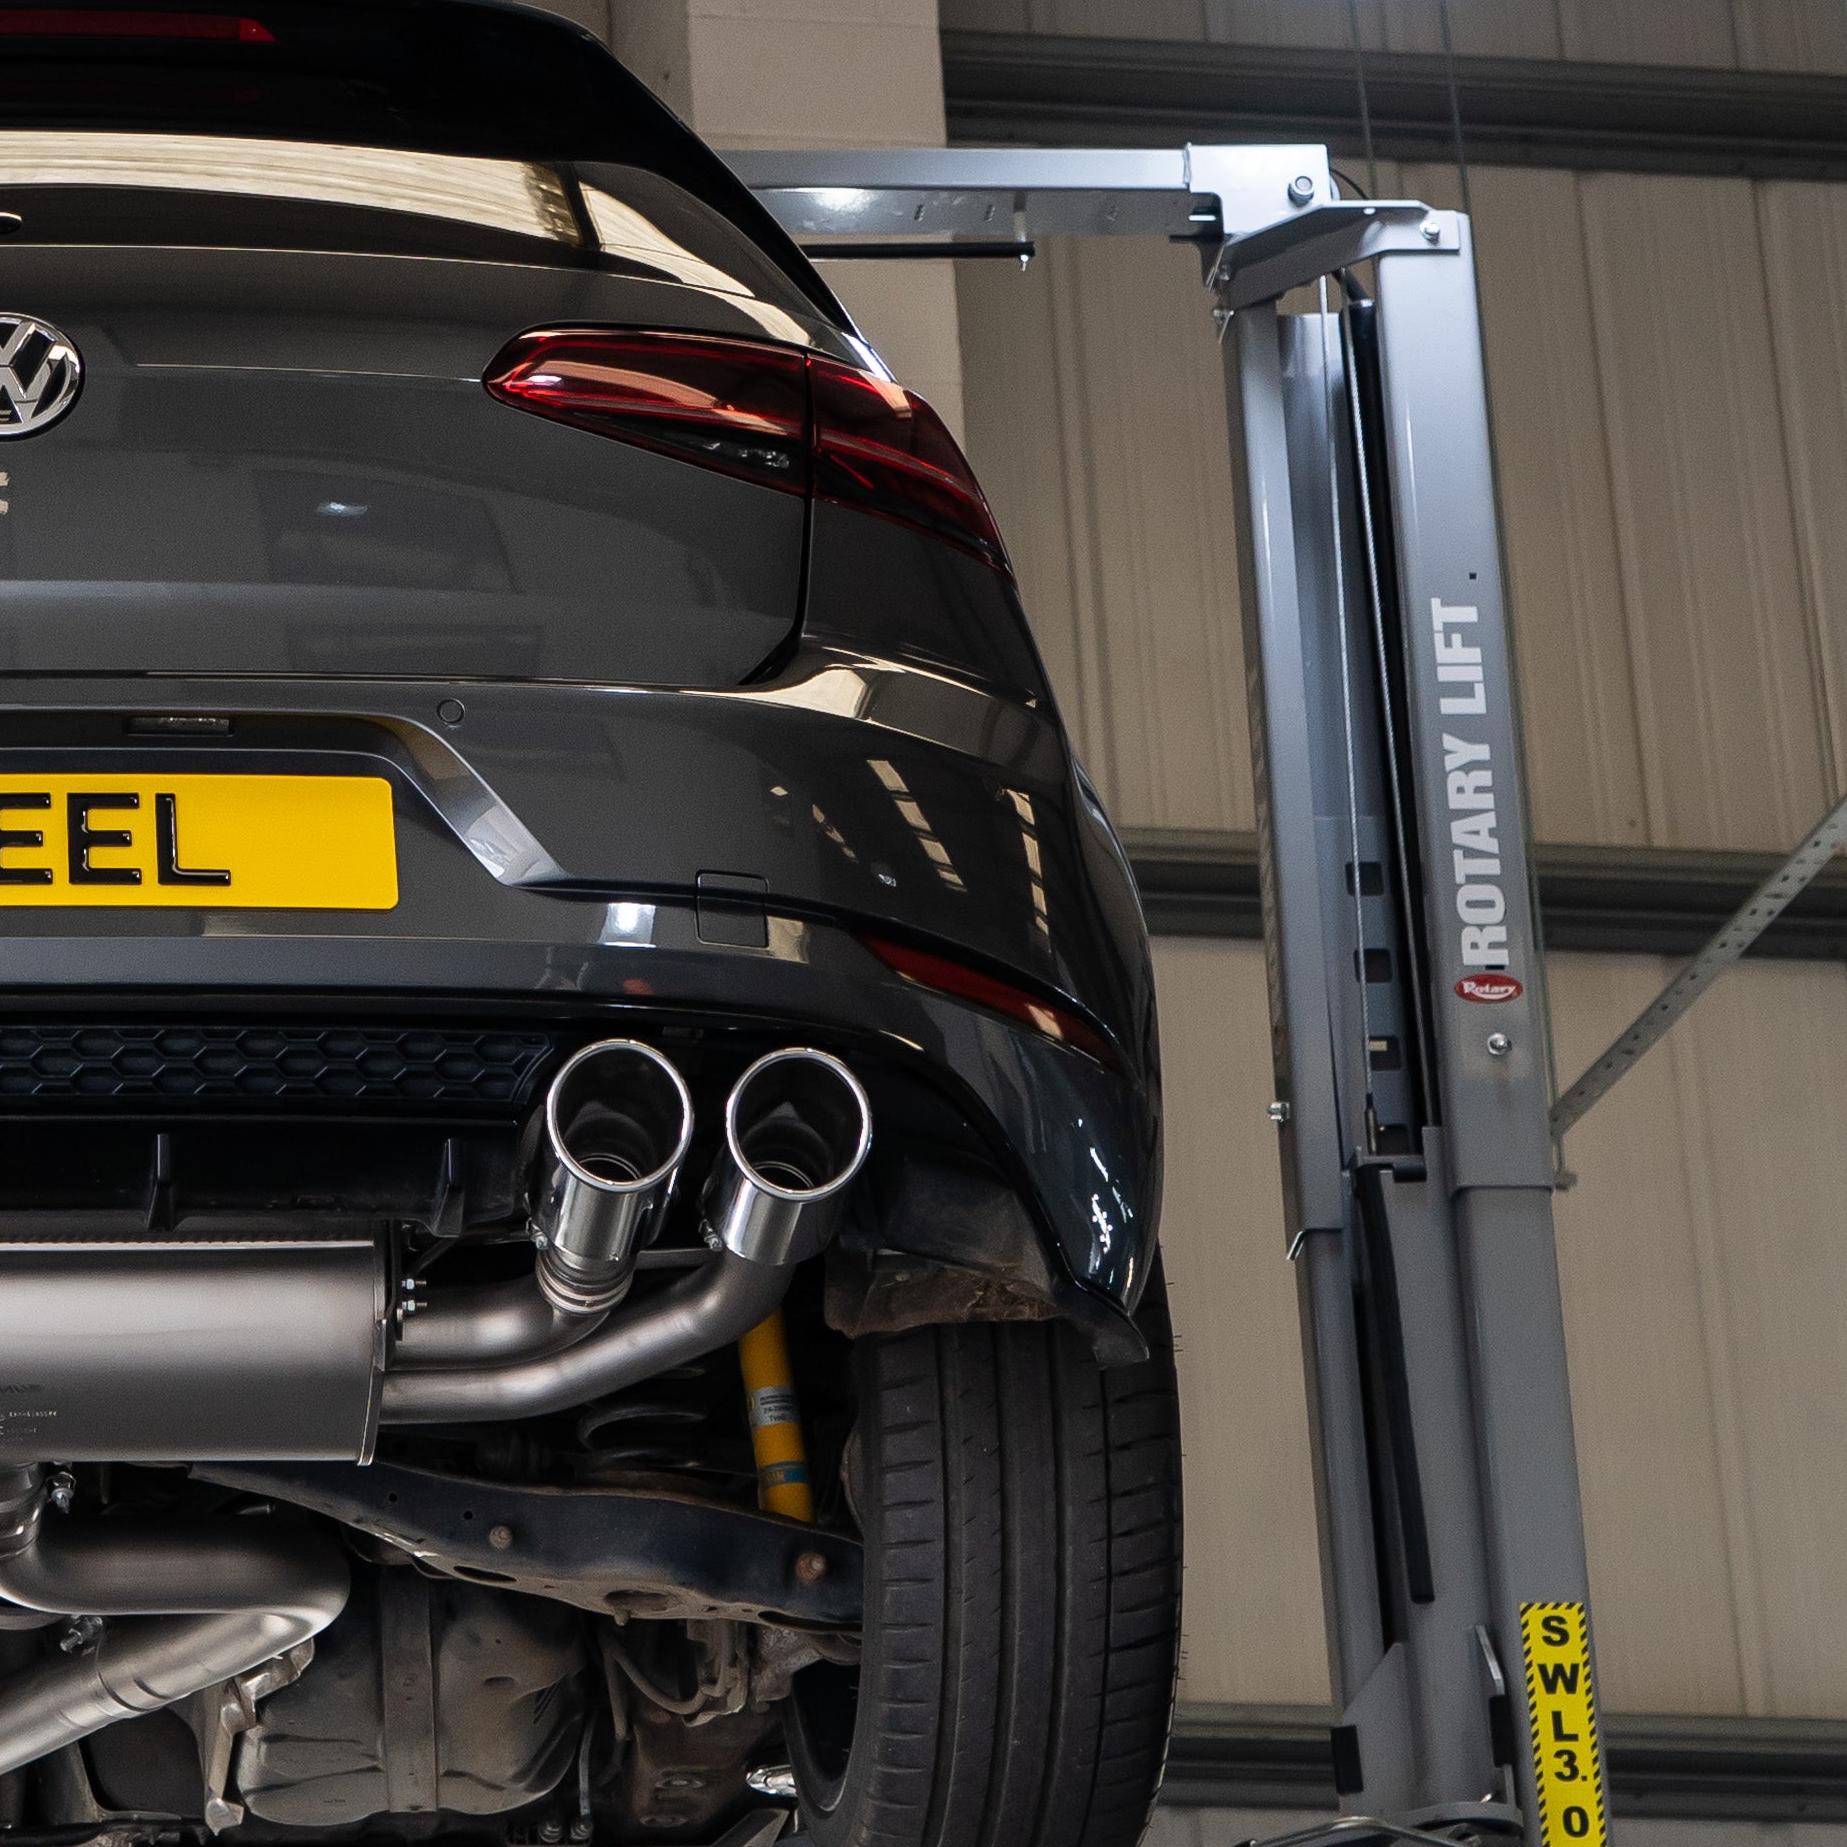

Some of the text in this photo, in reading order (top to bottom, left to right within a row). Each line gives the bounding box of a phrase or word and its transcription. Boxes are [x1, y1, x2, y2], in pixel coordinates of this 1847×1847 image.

[1431, 597, 1510, 967] ROTARY LIFT
[1461, 981, 1516, 999] Rotary
[1537, 1615, 1580, 1742] SWL
